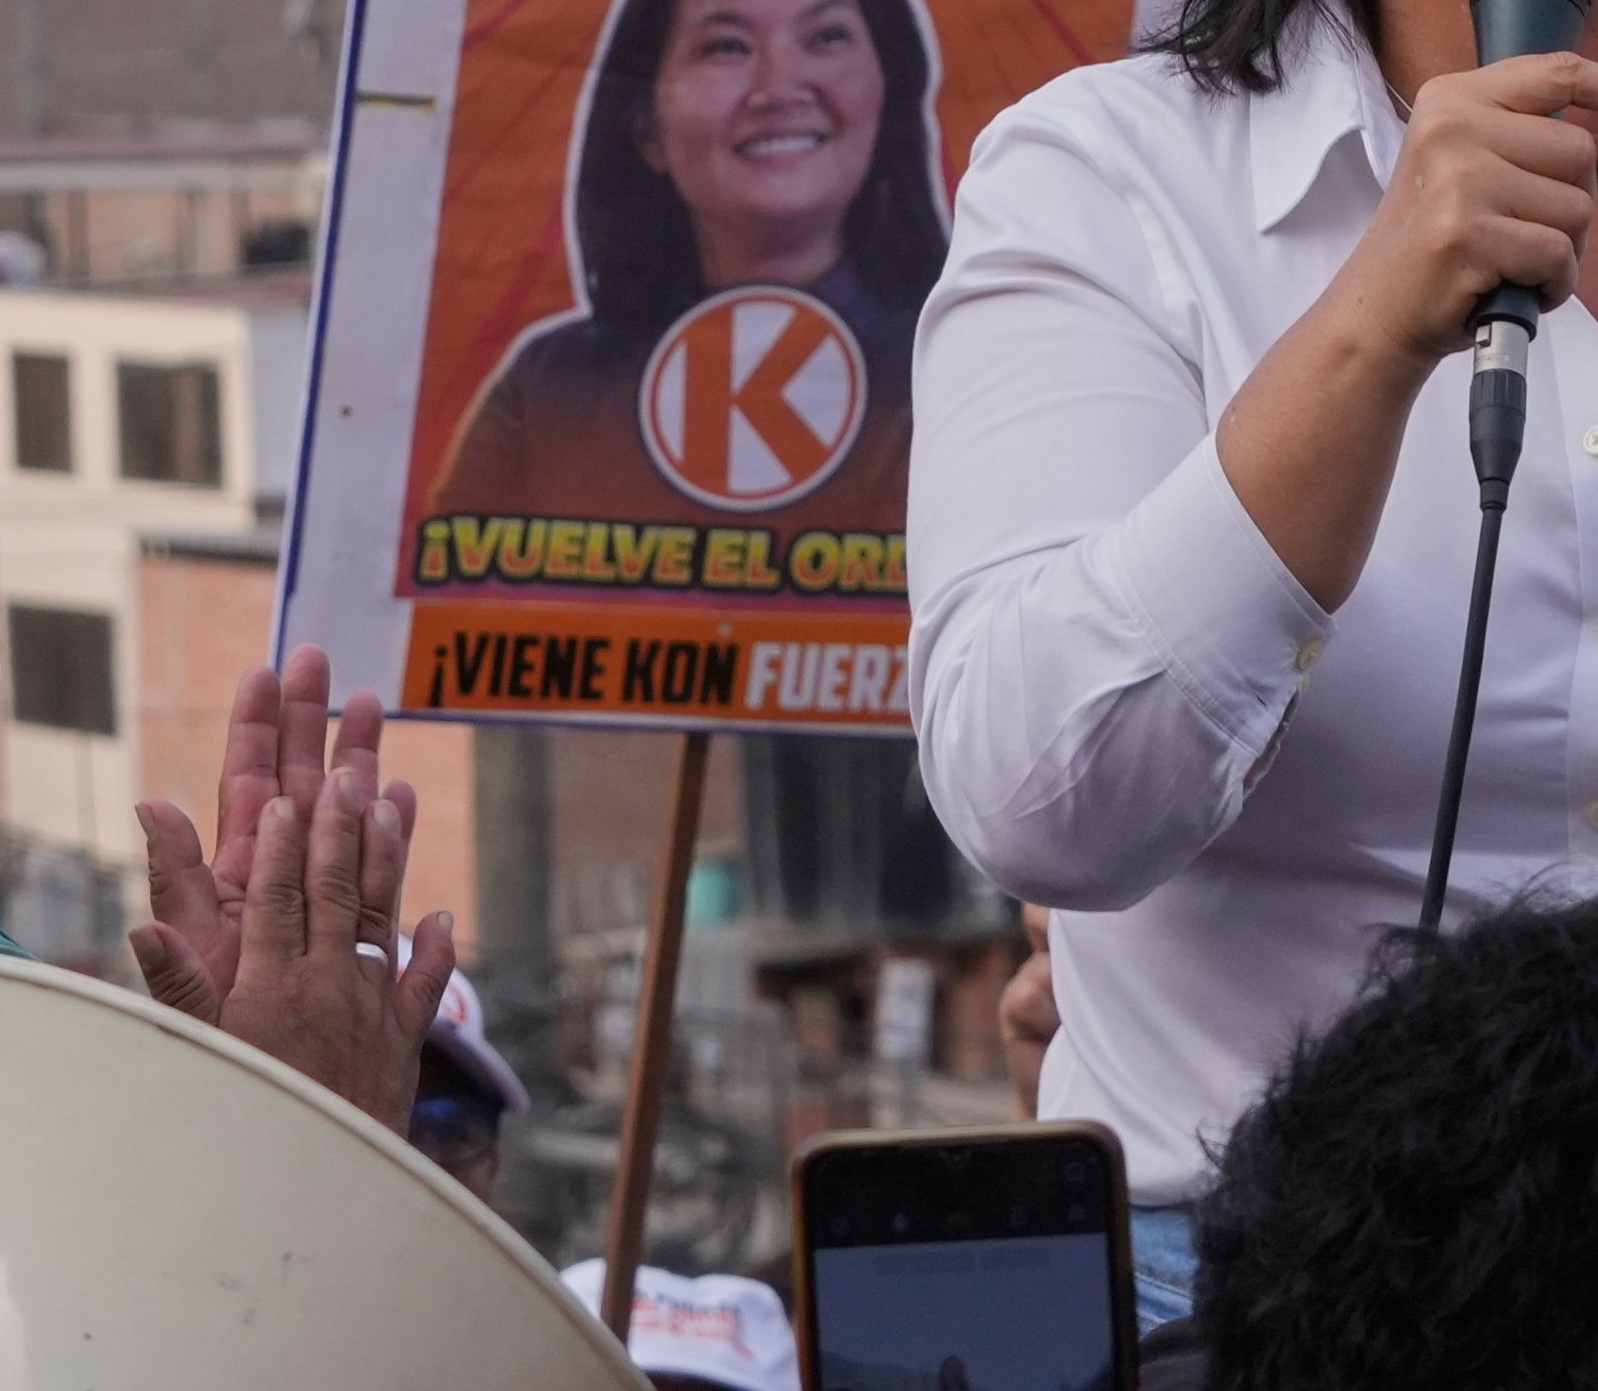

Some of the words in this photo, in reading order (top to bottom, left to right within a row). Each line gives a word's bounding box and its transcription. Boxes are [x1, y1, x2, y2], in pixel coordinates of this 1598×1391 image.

[675, 298, 833, 495] K
[419, 516, 698, 582] ¡VUELVE
[702, 527, 782, 589] EL
[429, 631, 610, 709] ¡VIENE
[621, 639, 740, 708] KON
